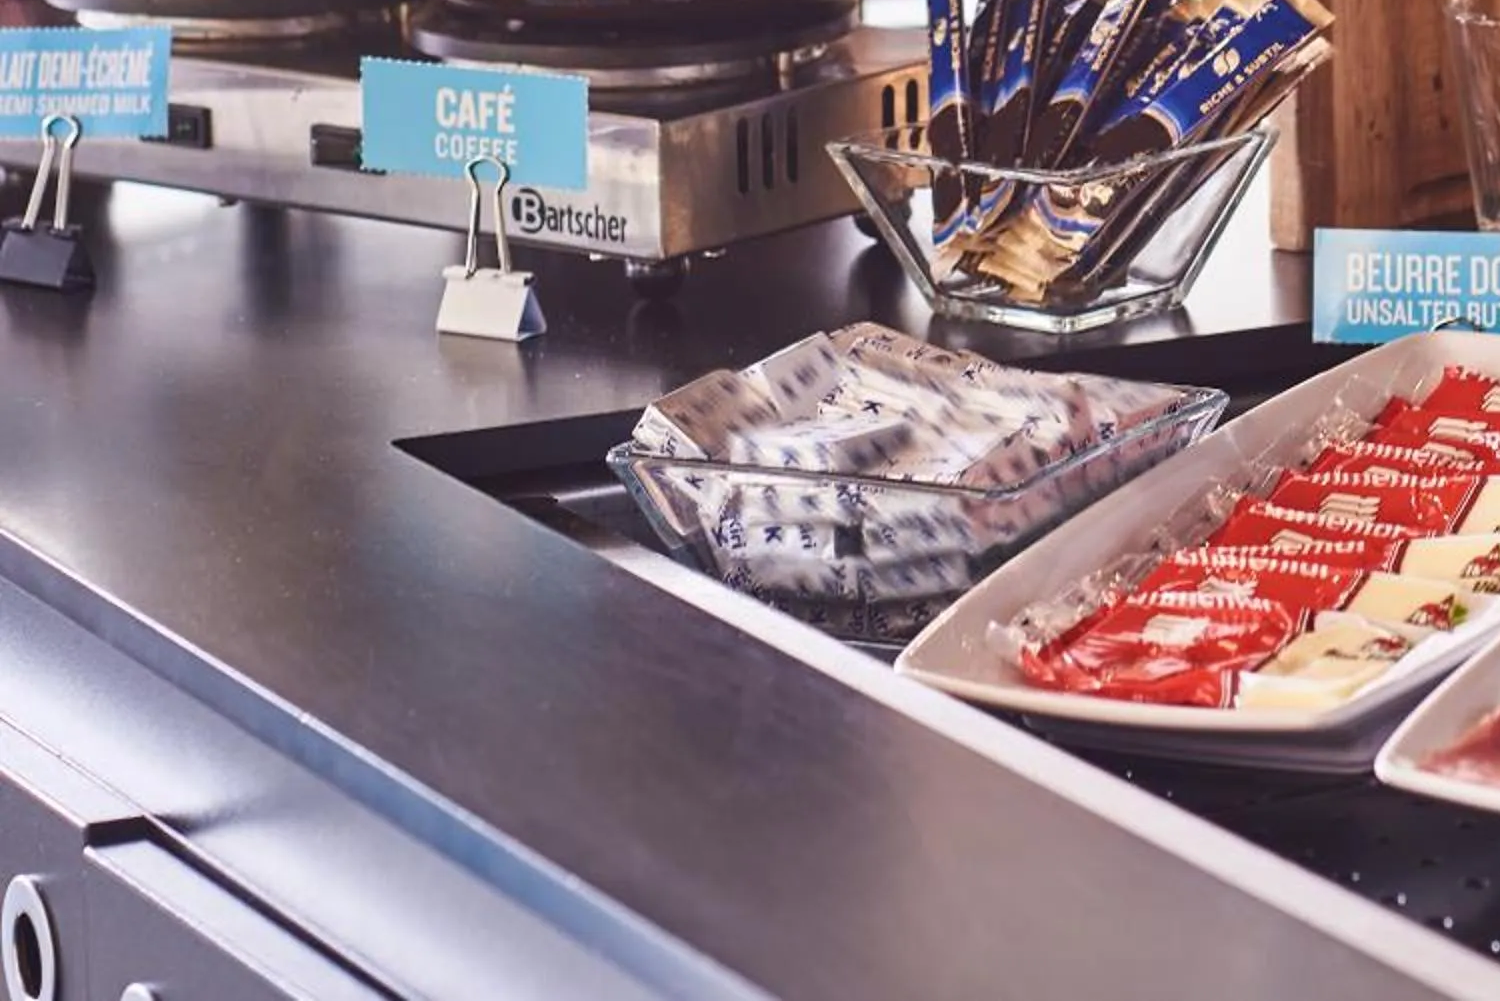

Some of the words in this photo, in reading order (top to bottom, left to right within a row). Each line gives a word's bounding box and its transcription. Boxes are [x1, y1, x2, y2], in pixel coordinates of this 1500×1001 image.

[0, 51, 37, 89] LAIT
[0, 94, 34, 116] EMI
[436, 83, 516, 134] CAFÉ
[435, 132, 518, 165] COFFEE
[512, 188, 627, 243] Bartscher
[1347, 252, 1462, 295] BEURRE
[1346, 299, 1460, 326] UNSALTED
